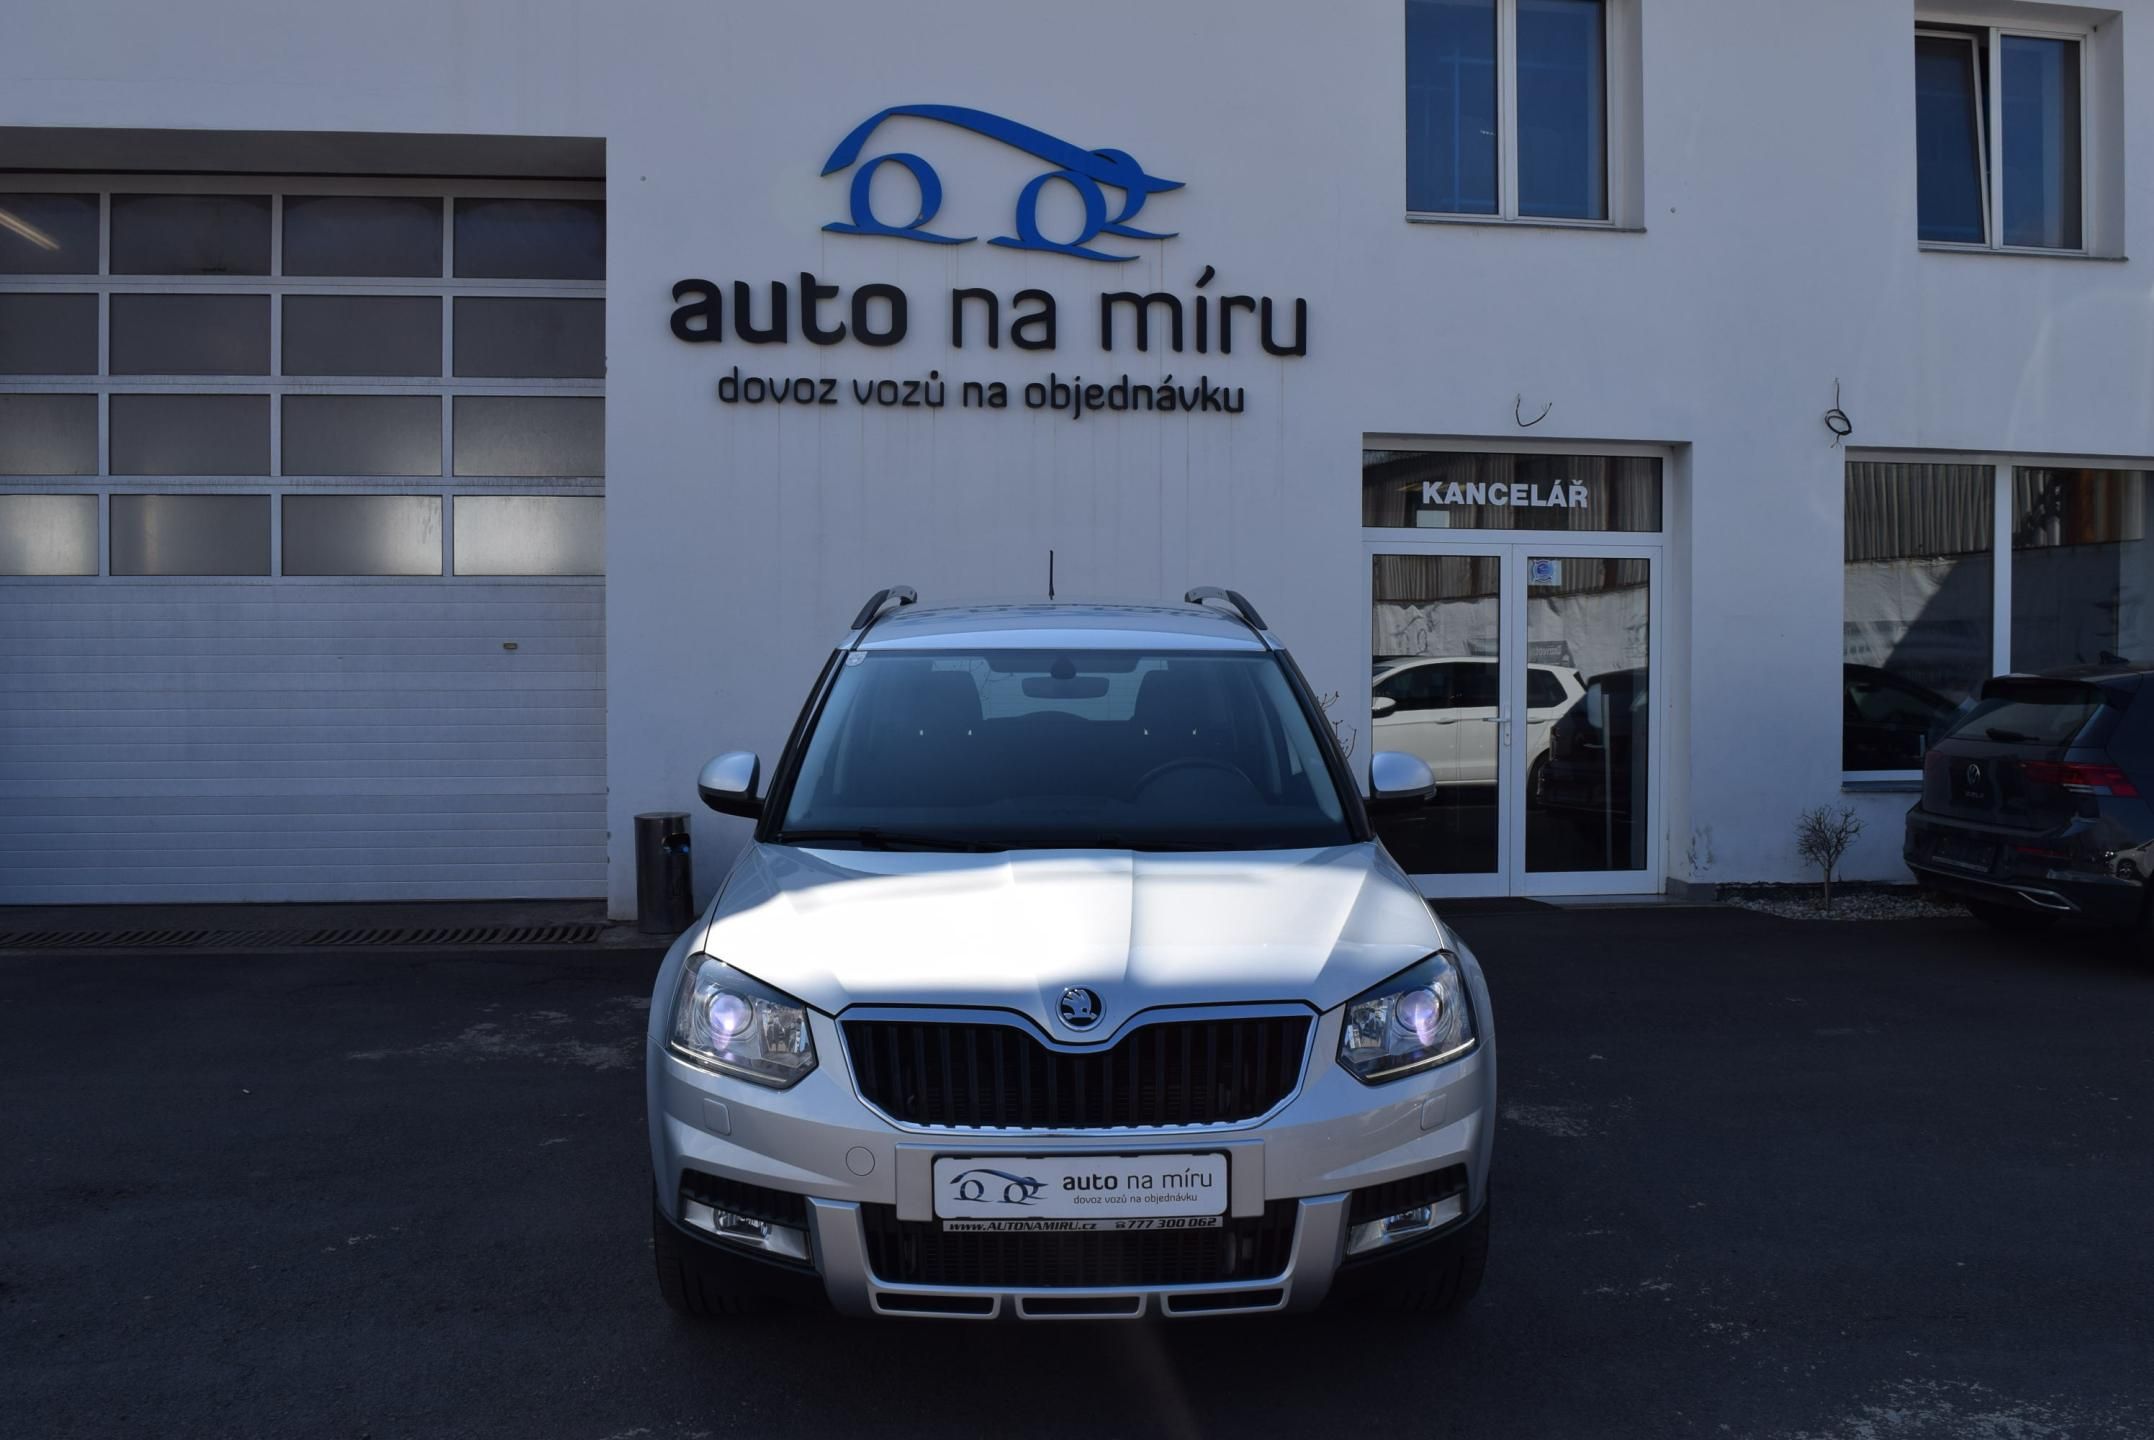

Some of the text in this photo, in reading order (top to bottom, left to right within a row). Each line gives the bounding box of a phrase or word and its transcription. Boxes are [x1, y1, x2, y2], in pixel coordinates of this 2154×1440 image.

[670, 264, 1308, 358] auto na míru
[718, 365, 1244, 420] dovoz vozů na objednávku
[1422, 479, 1588, 508] KANCELÁŘ
[1062, 1167, 1213, 1191] auto na míru
[1073, 1192, 1198, 1205] dovoz vozů na objednávku
[1127, 1217, 1217, 1229] 777 300 062
